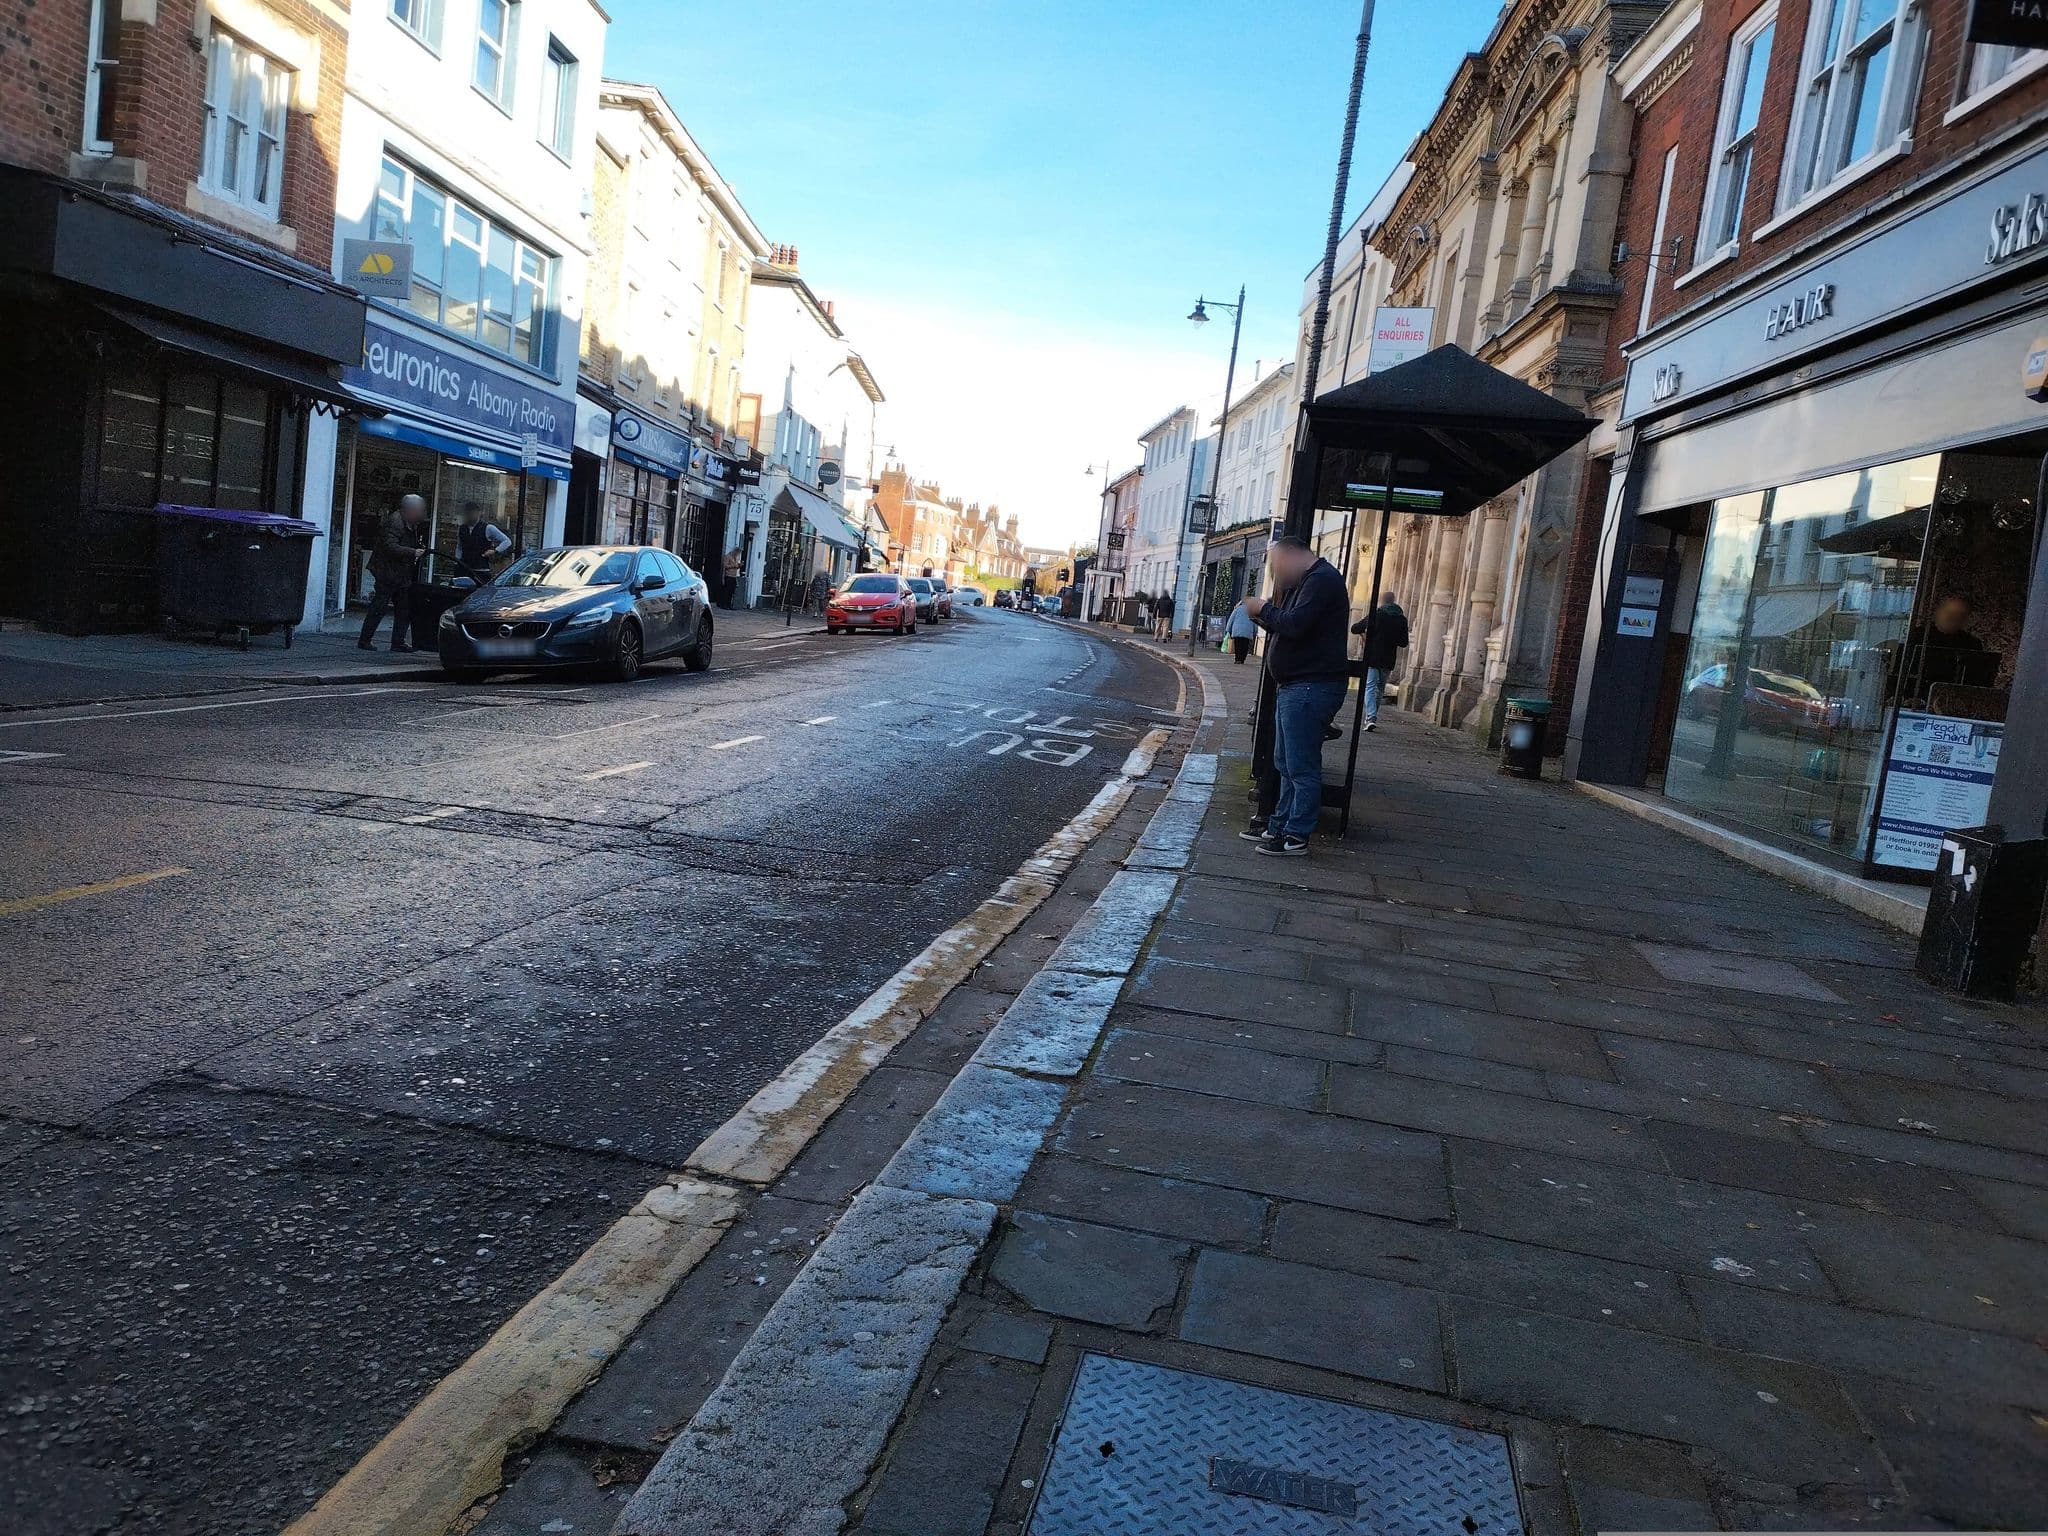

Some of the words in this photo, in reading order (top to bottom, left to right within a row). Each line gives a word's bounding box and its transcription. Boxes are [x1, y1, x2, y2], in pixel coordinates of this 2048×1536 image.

[2011, 0, 2048, 18] HA
[1984, 192, 2048, 265] Saks
[359, 276, 403, 286] ARCHITECTS
[1763, 284, 1833, 341] HAIR
[1394, 316, 1411, 327] ALL
[1377, 330, 1425, 341] ENQUIRIES
[368, 342, 461, 401] euronics
[467, 379, 519, 427] Albany
[521, 398, 556, 433] Radio
[1652, 362, 1682, 402] Saks
[749, 503, 762, 514] 75
[1924, 719, 1956, 732] Head
[1935, 731, 1968, 744] Short
[1889, 835, 1917, 846] Hertford
[1918, 840, 1939, 850] 01992
[1895, 844, 1912, 853] book
[1216, 1461, 1347, 1512] WATER
